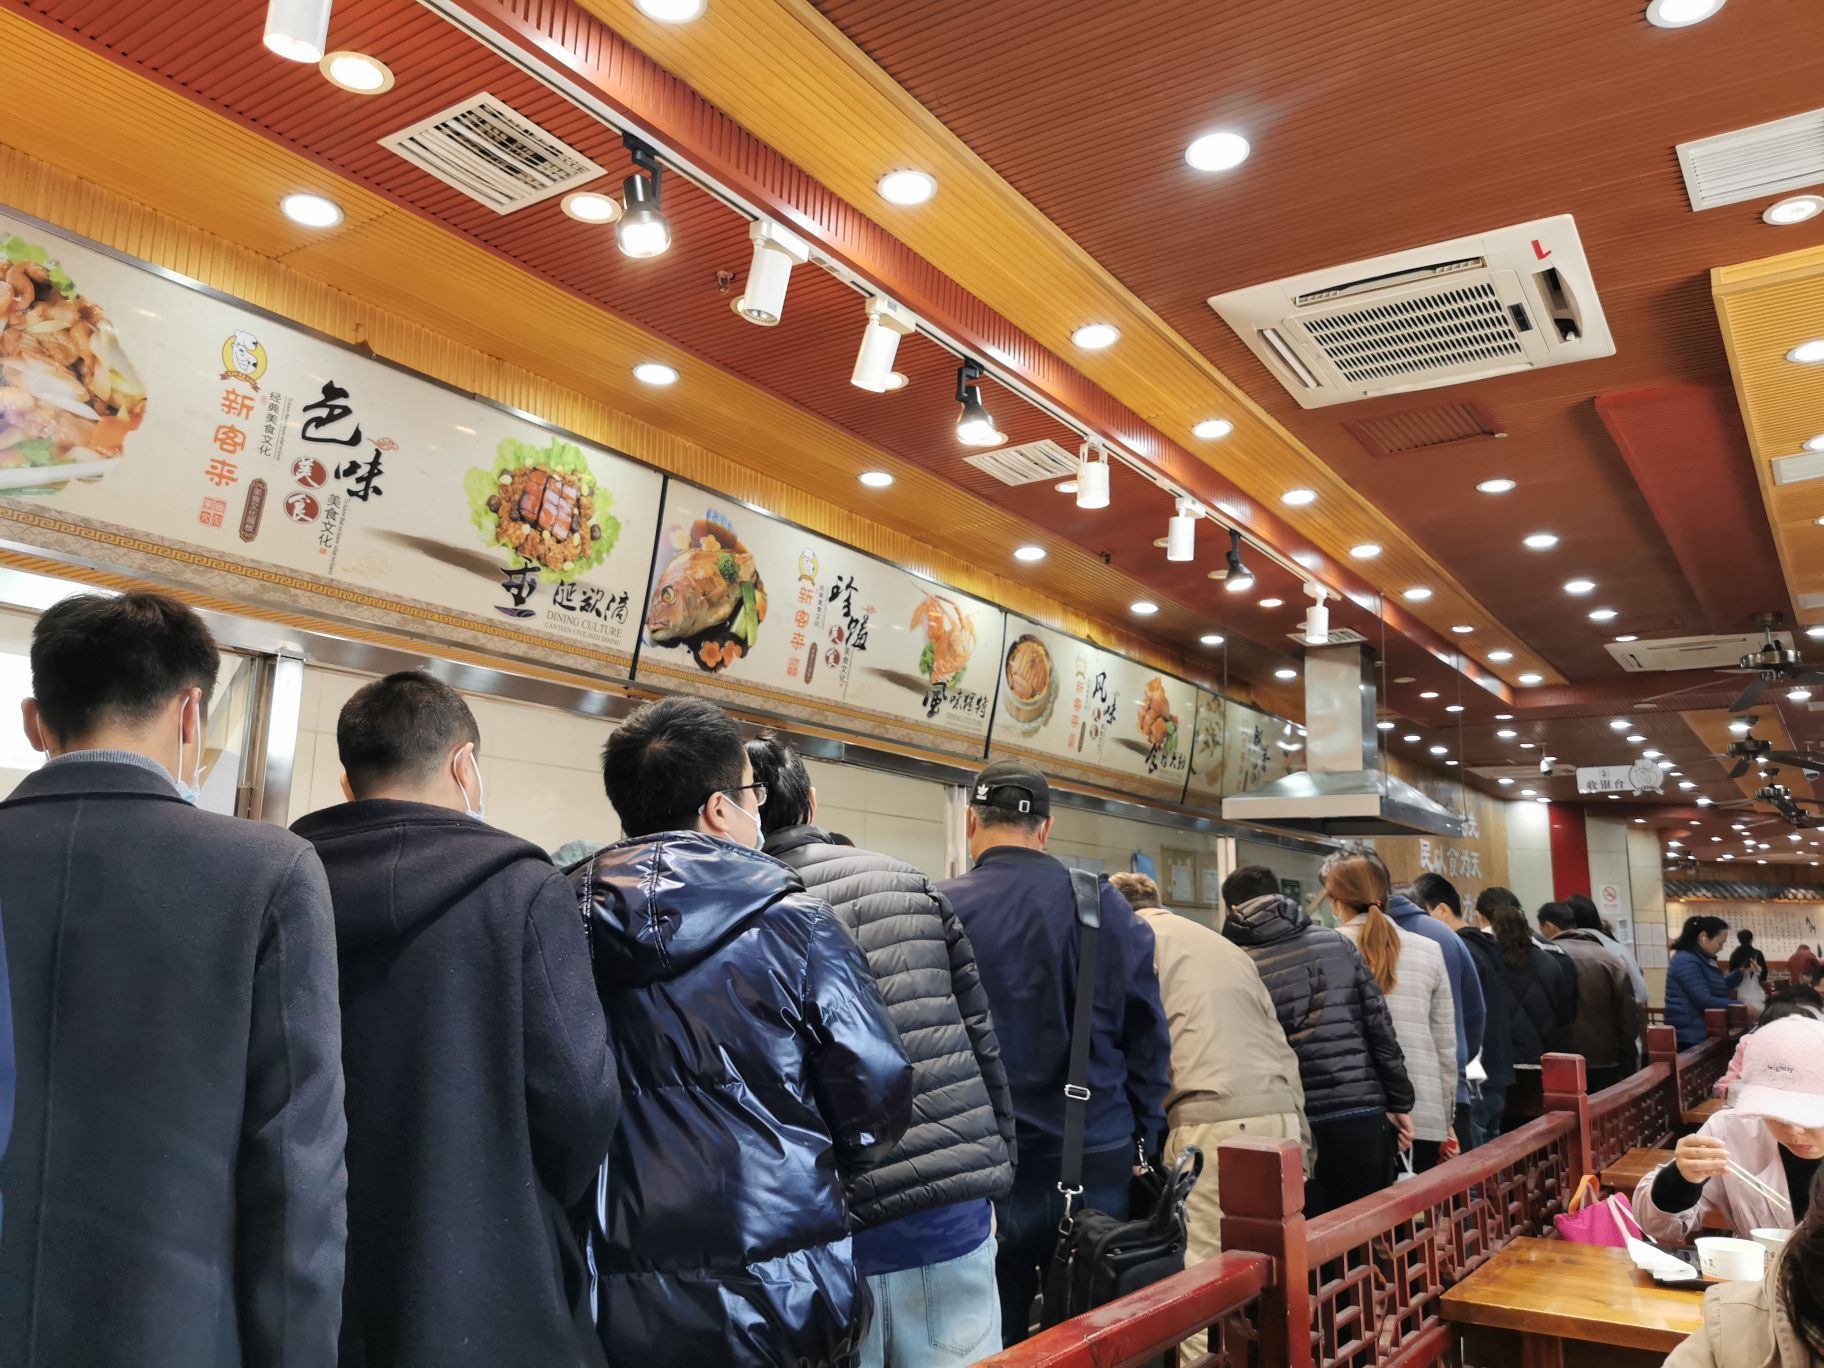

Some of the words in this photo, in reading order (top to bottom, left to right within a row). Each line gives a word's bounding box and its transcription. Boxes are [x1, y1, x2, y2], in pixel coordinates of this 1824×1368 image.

[204, 388, 256, 487] 新客来
[259, 391, 281, 457] 经典美食文化
[302, 380, 384, 501] 色味
[286, 456, 322, 522] 美食
[318, 493, 341, 549] 美食文化
[546, 610, 580, 627] DINING
[582, 620, 623, 638] CULTURE
[790, 587, 813, 650] 新客来
[1419, 838, 1482, 880] 民以食为天
